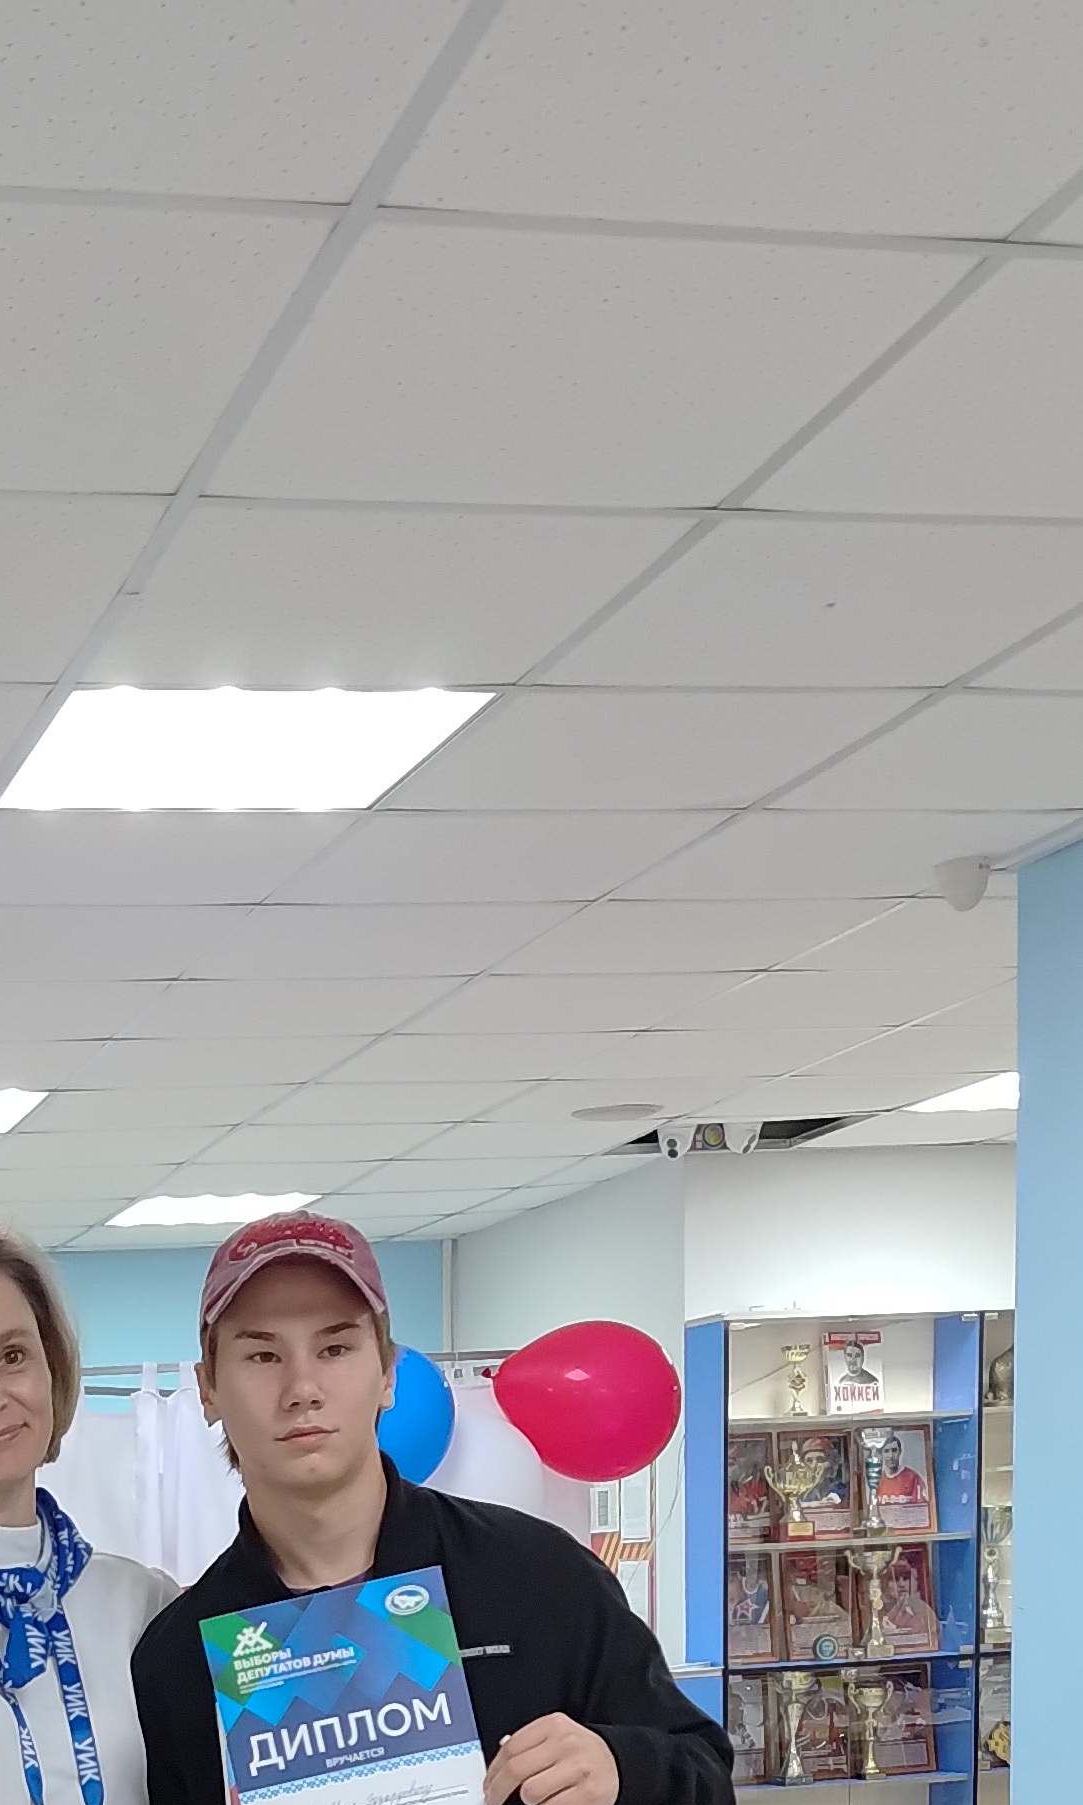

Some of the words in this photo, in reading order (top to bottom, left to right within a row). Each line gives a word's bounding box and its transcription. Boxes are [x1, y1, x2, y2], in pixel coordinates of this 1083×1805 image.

[834, 1382, 879, 1402] ХОККЕЙ
[51, 1628, 77, 1666] УИК
[233, 1648, 292, 1671] ВЫБОРЫ
[237, 1657, 312, 1685] ДЕПУТАТОВ
[313, 1646, 355, 1667] ДУМЫ
[62, 1681, 88, 1721] УИК
[19, 1724, 39, 1770] УИК
[249, 1692, 452, 1777] ДИПЛОМ
[74, 1736, 101, 1786] УИК
[325, 1746, 385, 1768] ВРУЧАЕТСЯ
